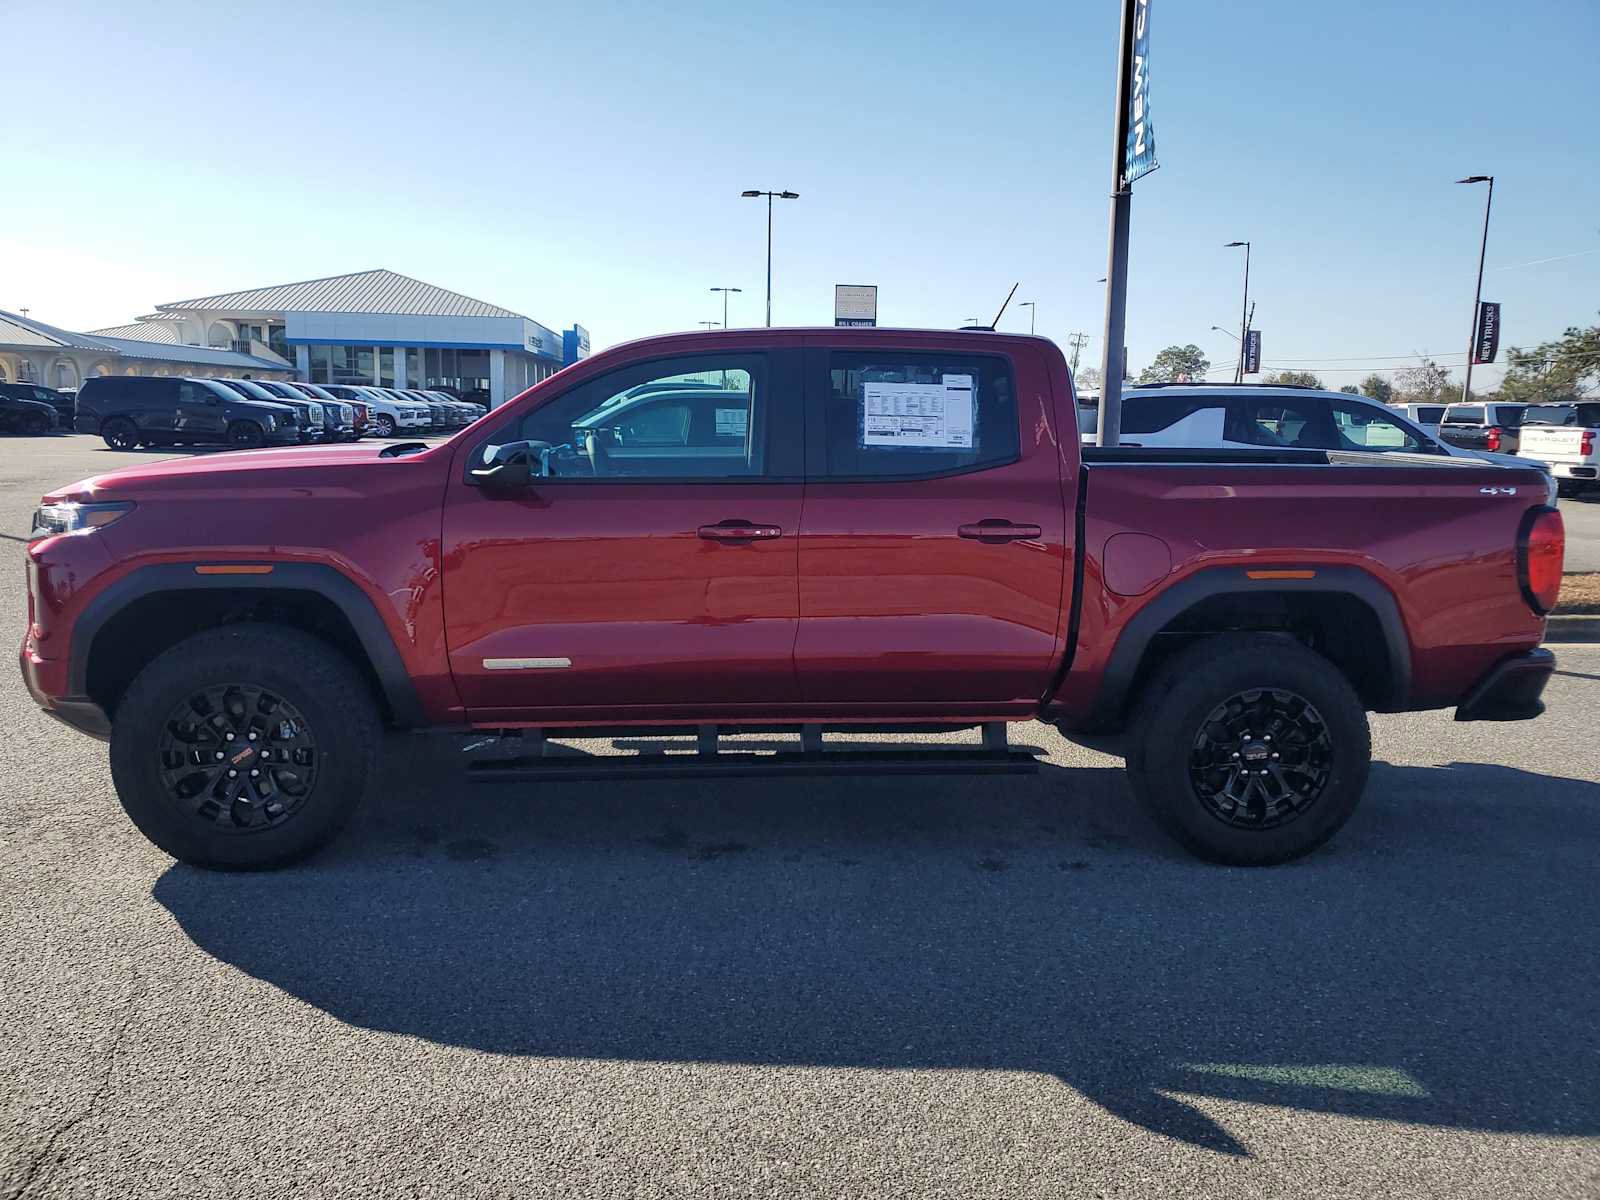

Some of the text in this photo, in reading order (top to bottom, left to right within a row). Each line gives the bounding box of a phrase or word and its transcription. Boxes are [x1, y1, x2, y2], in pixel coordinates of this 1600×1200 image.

[1134, 55, 1145, 157] NEW
[1249, 332, 1257, 356] TRUCKS
[1480, 305, 1494, 361] NEW TRUCKS
